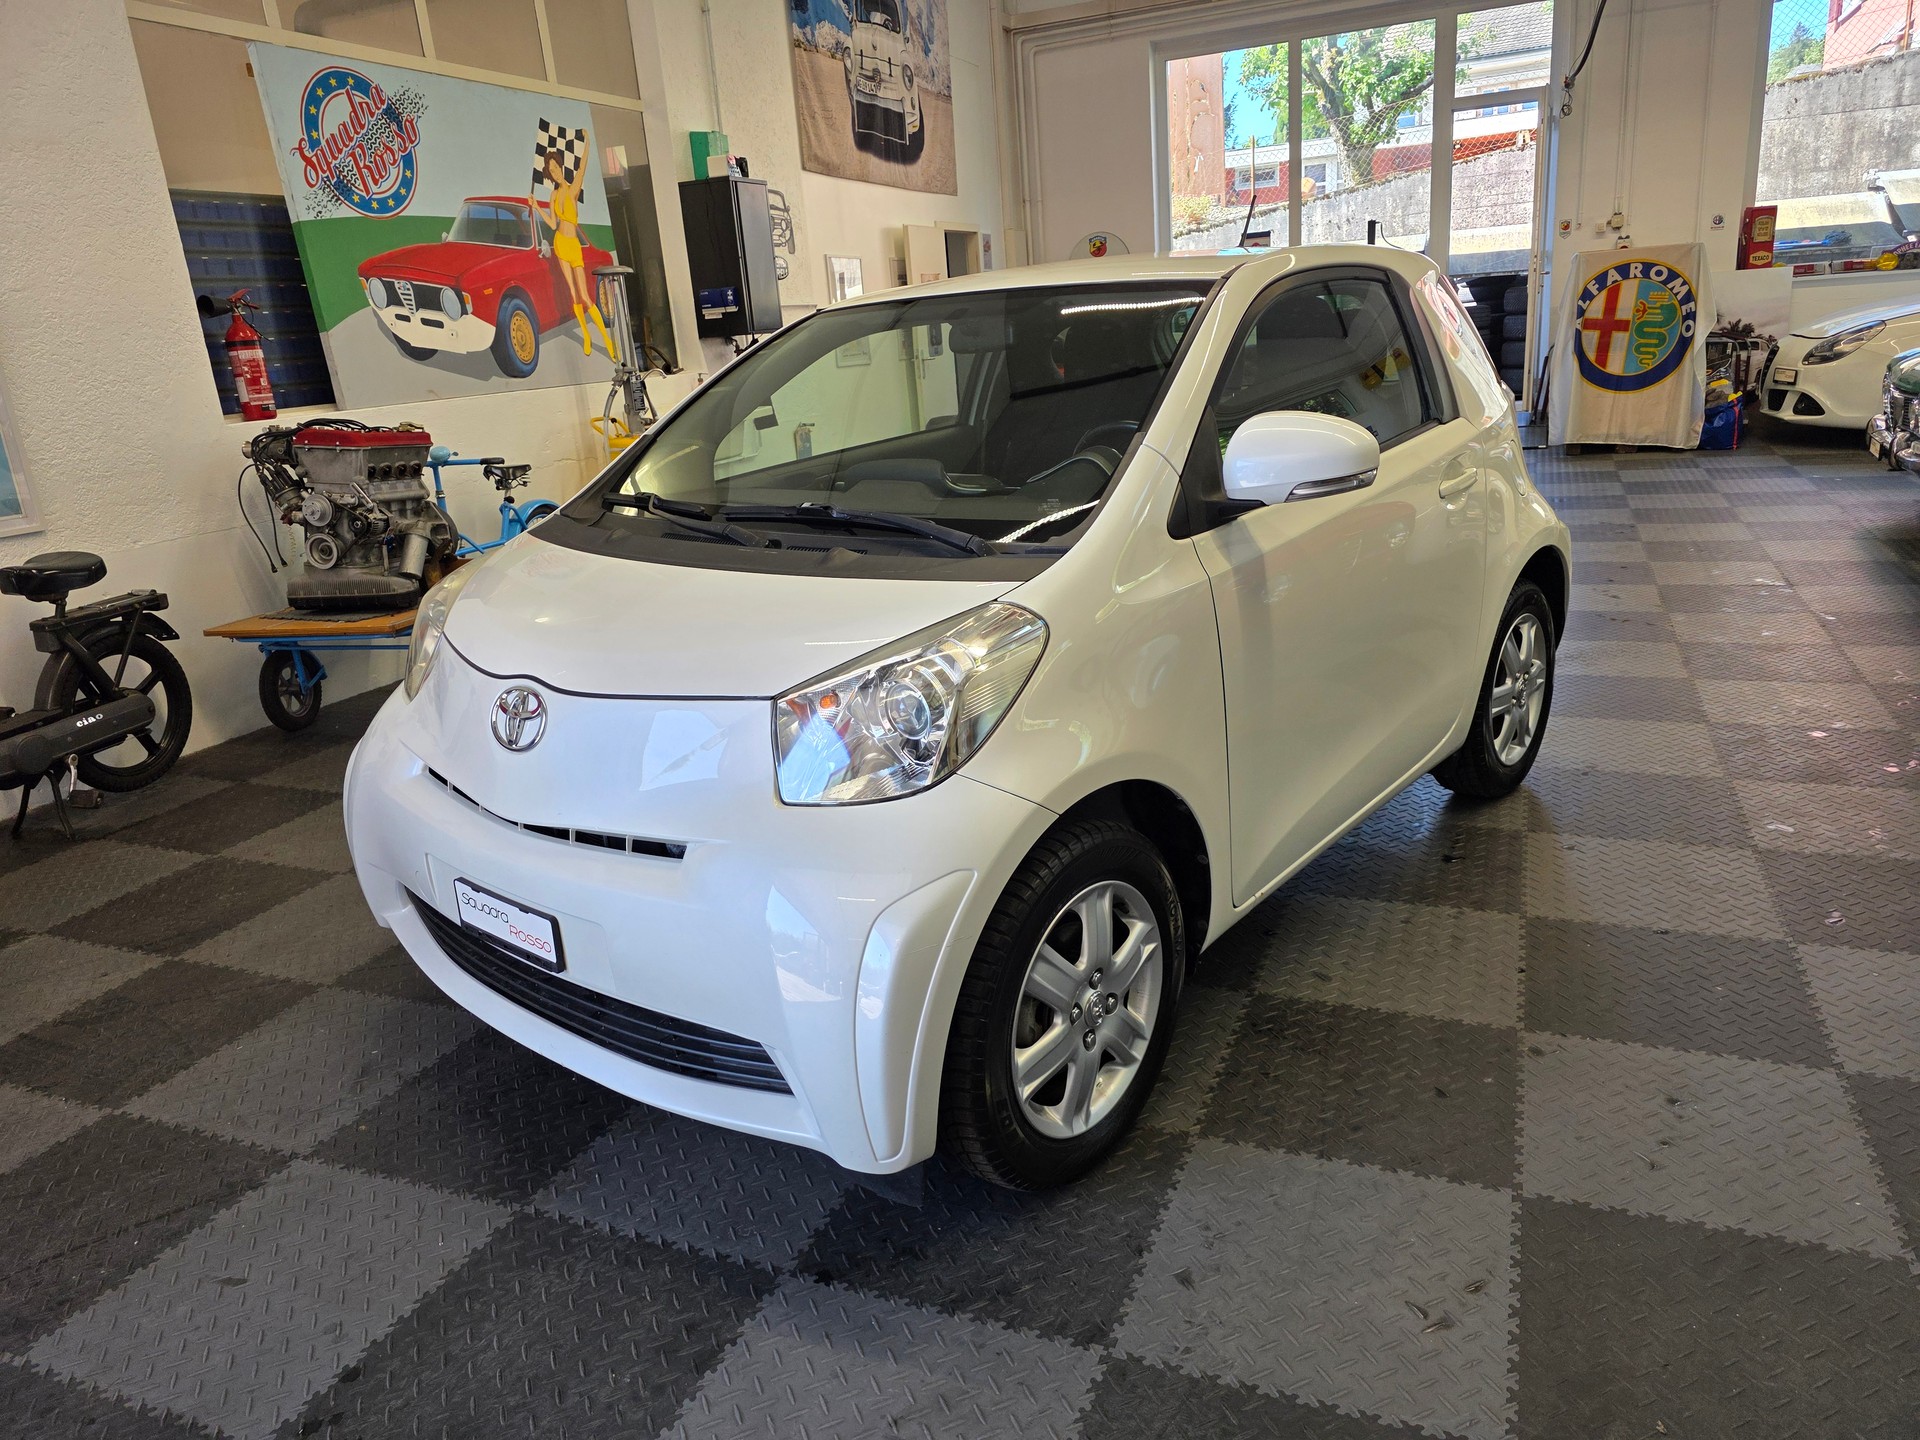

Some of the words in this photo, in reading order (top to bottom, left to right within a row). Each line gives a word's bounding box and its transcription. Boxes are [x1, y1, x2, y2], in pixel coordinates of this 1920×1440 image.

[289, 83, 387, 188] Squadra
[343, 113, 420, 199] Rosso
[76, 713, 103, 727] ciao
